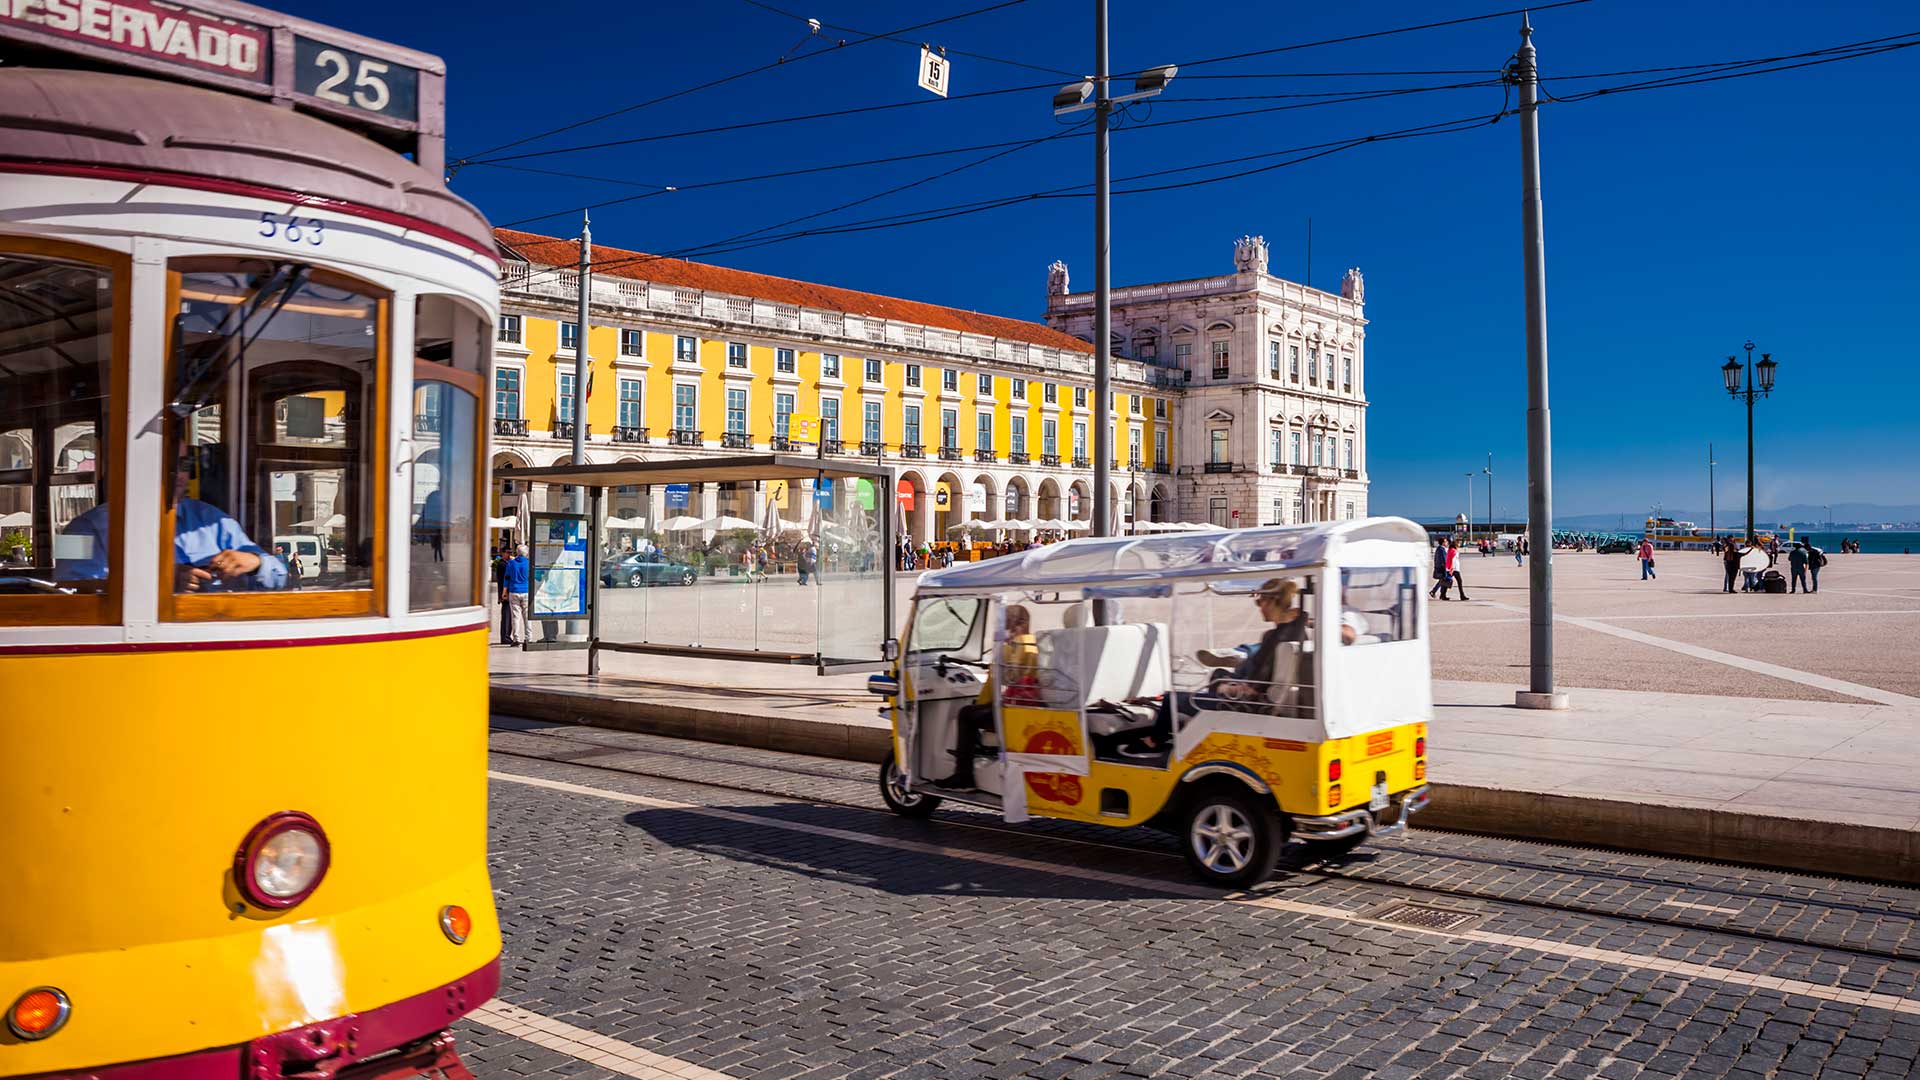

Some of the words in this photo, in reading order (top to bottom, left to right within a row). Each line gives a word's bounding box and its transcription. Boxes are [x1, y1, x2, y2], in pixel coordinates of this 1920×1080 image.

[0, 0, 258, 72] ESERVADO
[314, 50, 390, 111] 25
[929, 61, 940, 80] 15
[259, 212, 324, 246] 563
